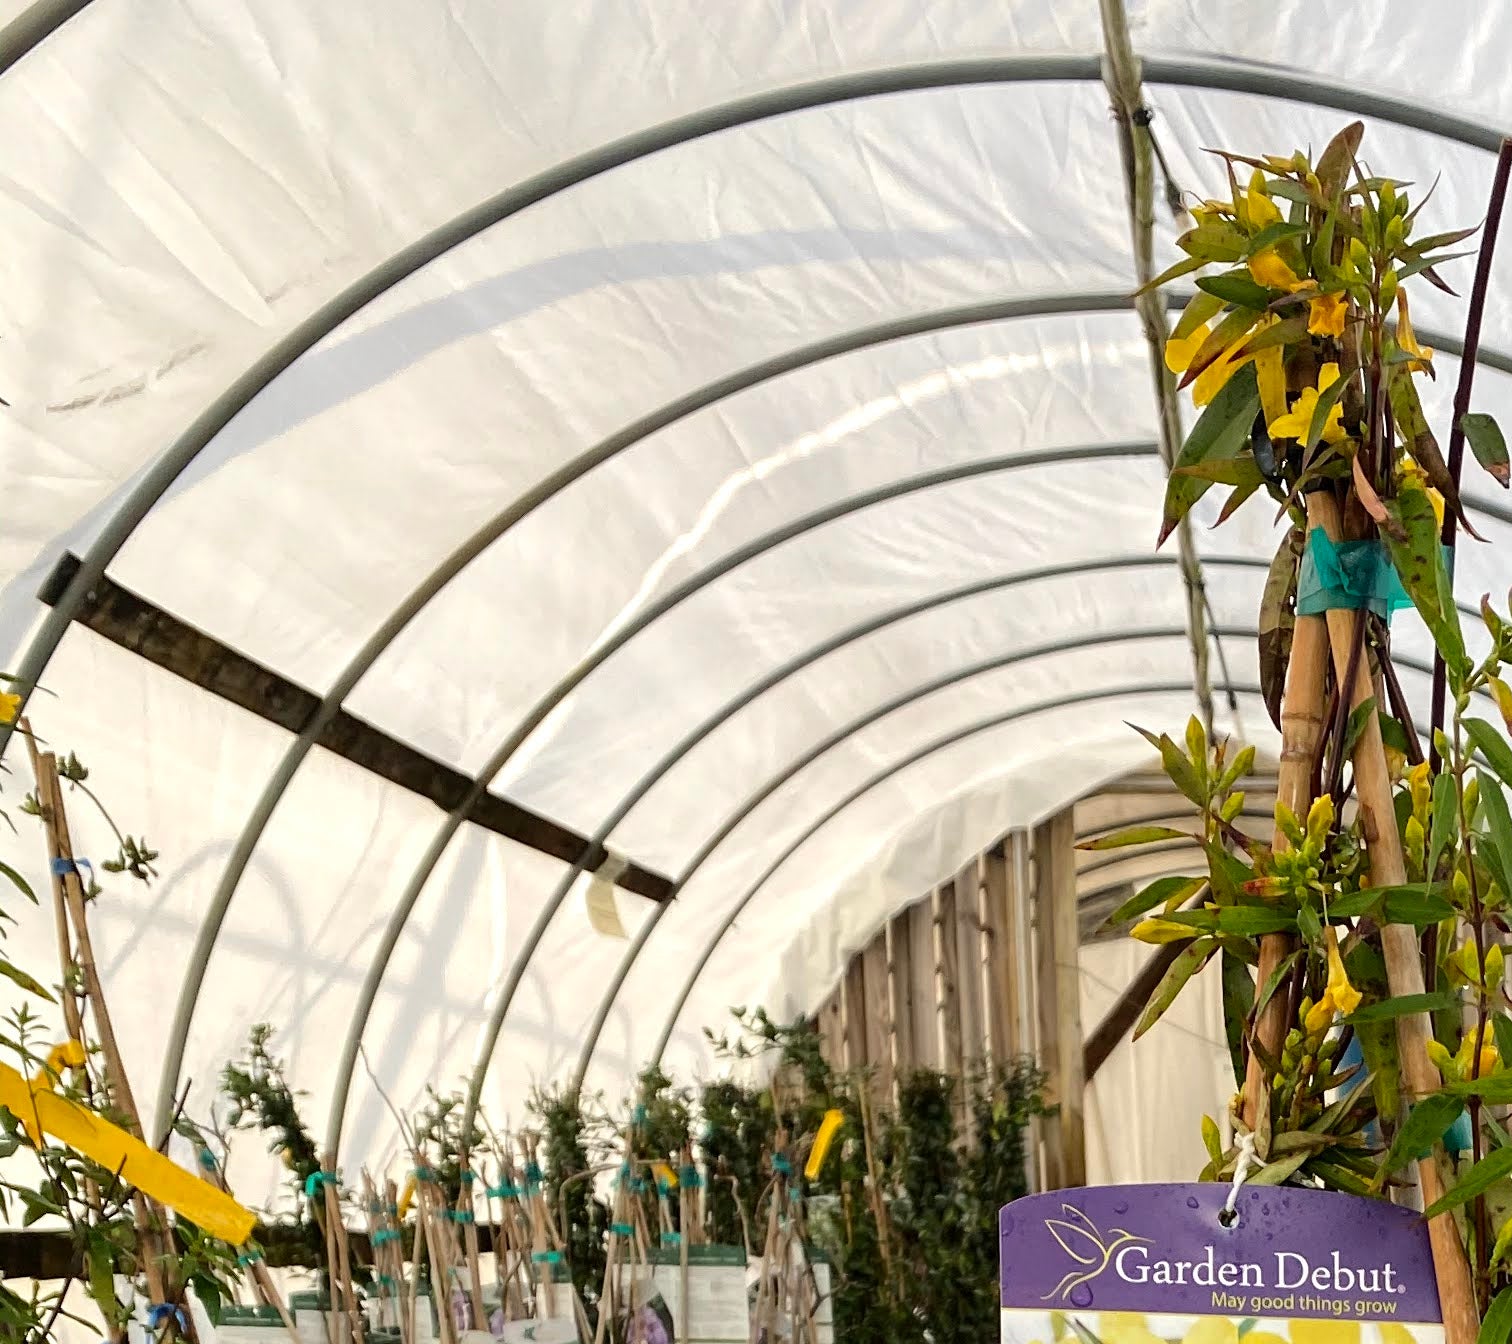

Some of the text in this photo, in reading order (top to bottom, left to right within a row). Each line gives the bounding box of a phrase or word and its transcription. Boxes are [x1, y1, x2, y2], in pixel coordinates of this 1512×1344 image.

[1115, 1246, 1265, 1287] Garden
[1212, 1291, 1397, 1316] May good things grow
